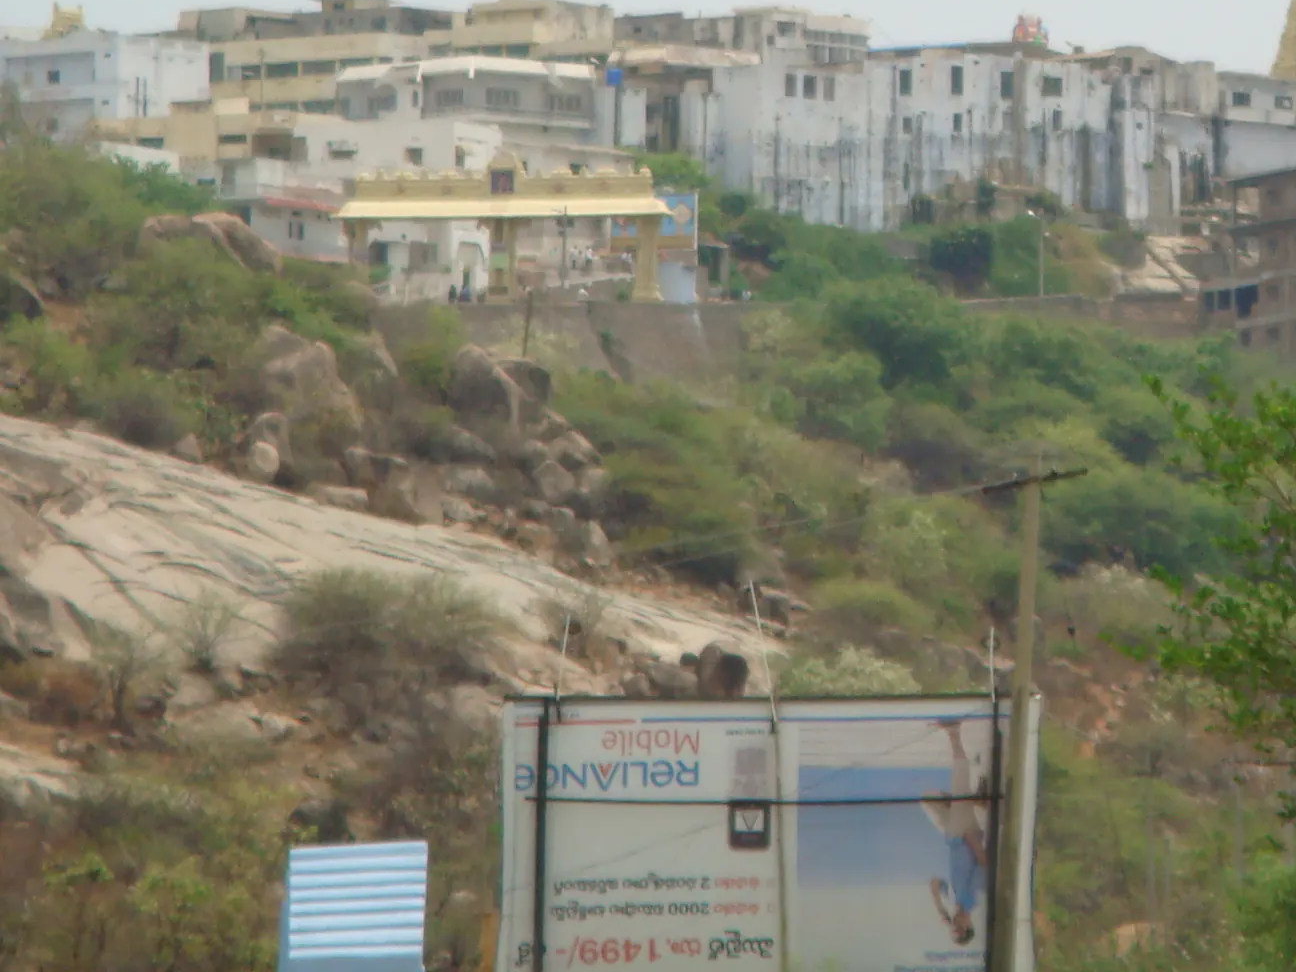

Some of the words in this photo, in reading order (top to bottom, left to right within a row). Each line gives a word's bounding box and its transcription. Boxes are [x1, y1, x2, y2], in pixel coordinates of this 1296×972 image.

[602, 728, 700, 757] Mobile
[700, 876, 710, 890] 2
[667, 902, 710, 916] 2000
[555, 935, 662, 970] 1499/-
